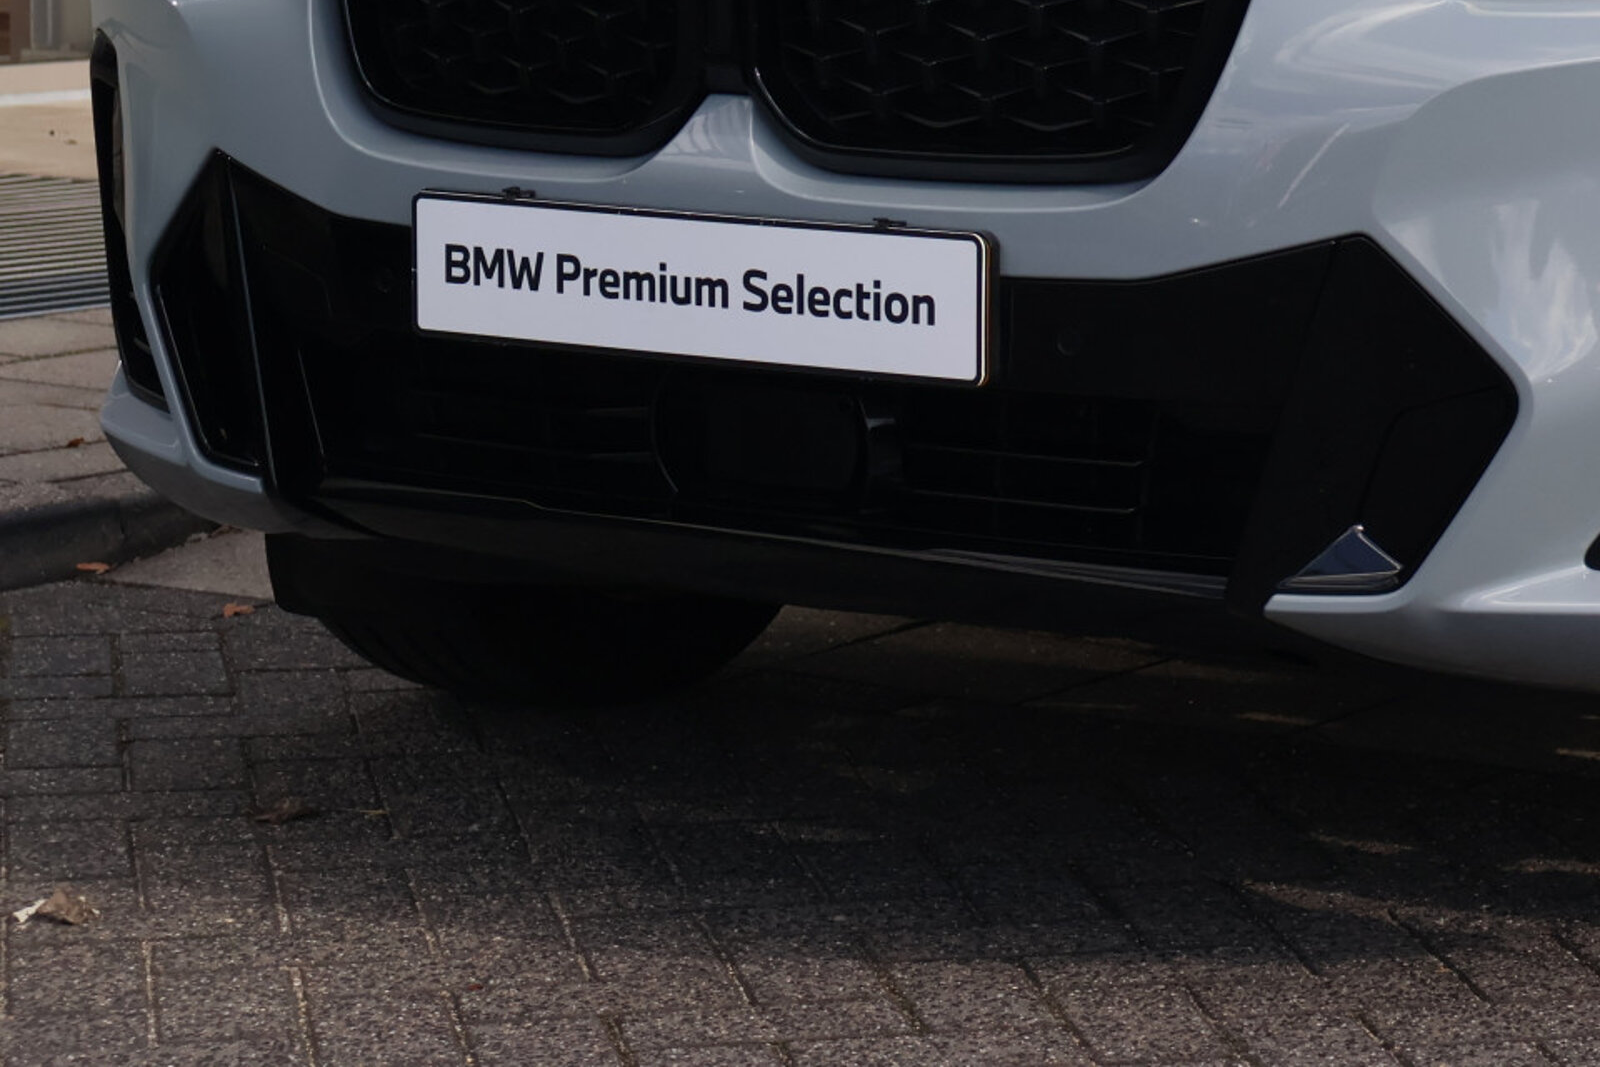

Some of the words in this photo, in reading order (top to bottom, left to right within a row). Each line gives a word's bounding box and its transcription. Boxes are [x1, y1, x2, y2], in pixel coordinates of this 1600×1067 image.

[443, 243, 545, 292] BMW
[556, 252, 730, 310] Premium
[741, 269, 937, 327] Selection
